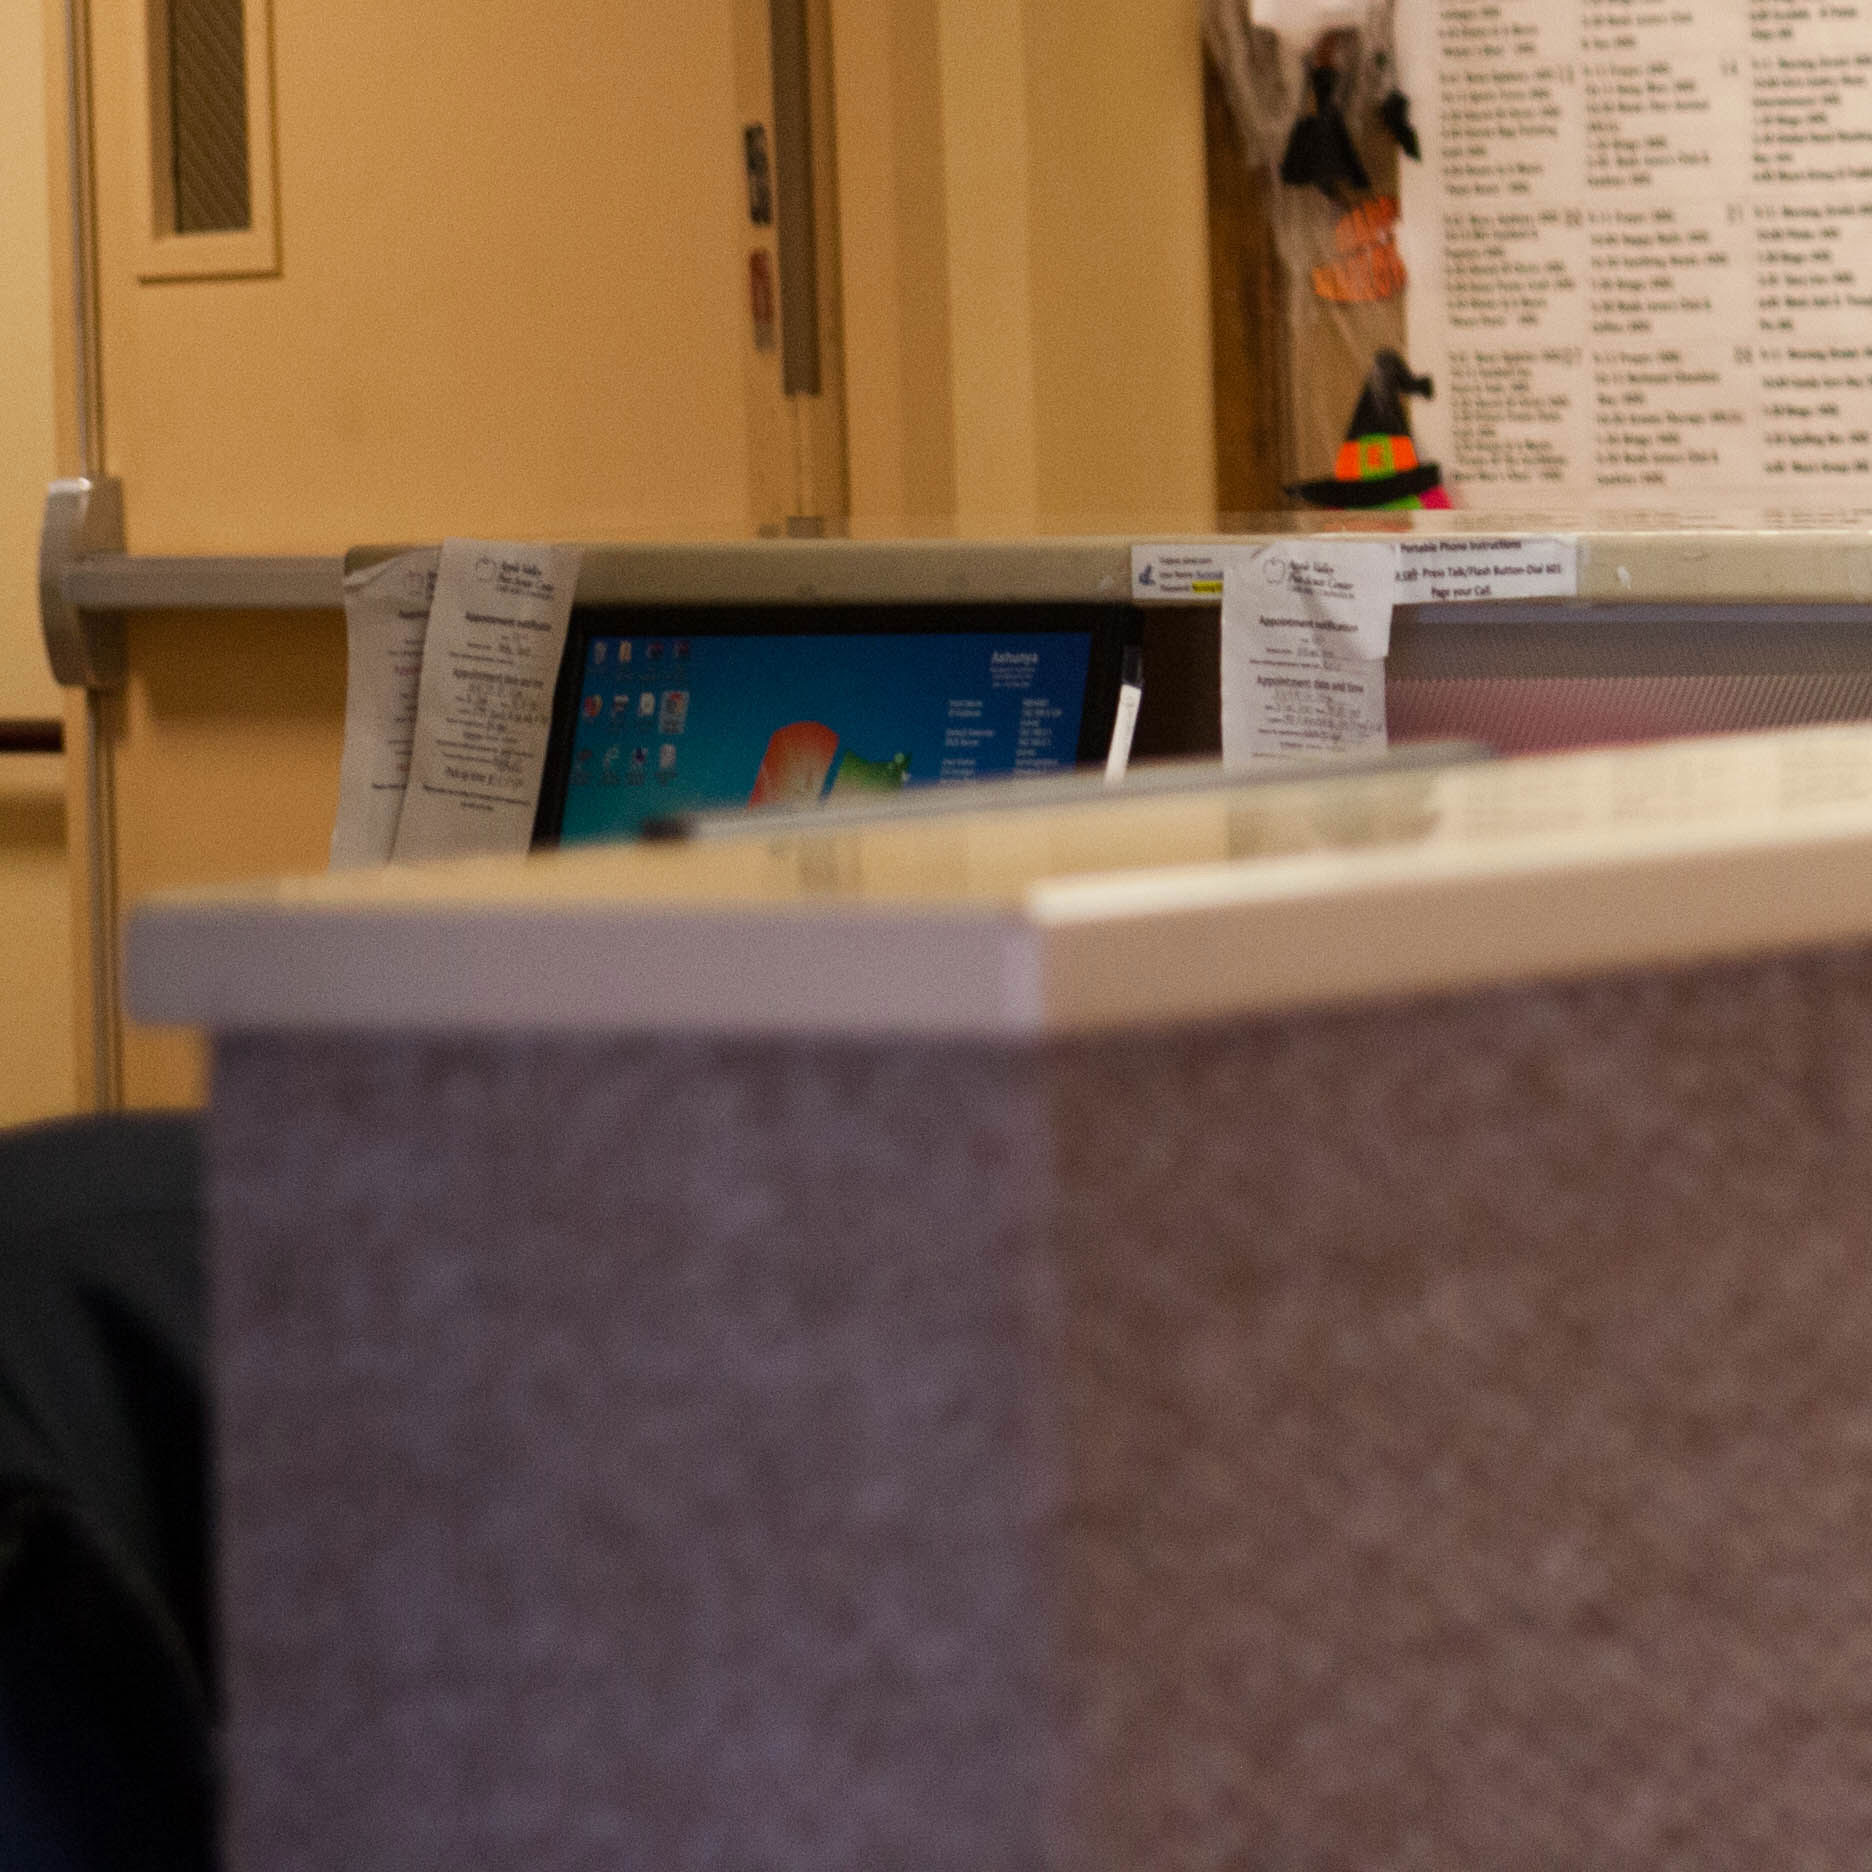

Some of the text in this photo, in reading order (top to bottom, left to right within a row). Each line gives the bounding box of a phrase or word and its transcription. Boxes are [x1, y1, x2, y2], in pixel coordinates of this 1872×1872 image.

[1400, 539, 1522, 553] Portable Phone Instructions
